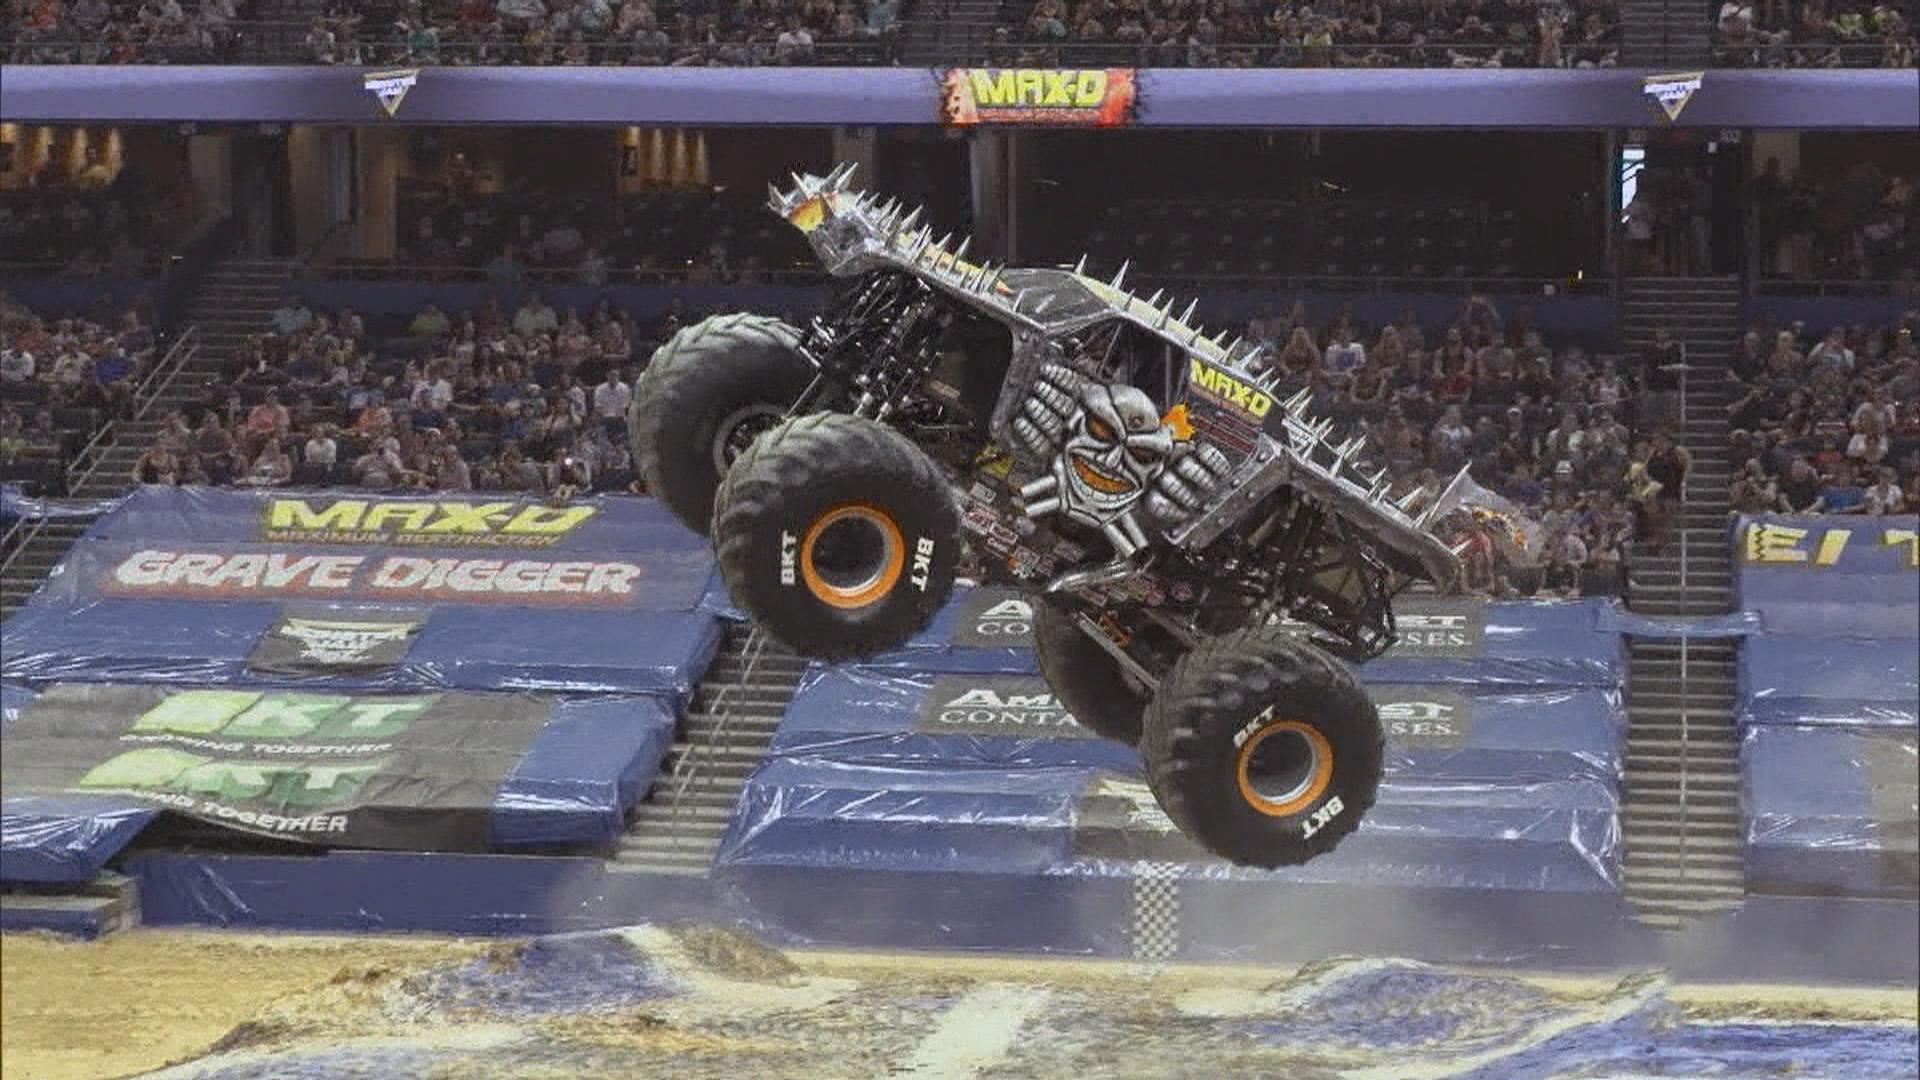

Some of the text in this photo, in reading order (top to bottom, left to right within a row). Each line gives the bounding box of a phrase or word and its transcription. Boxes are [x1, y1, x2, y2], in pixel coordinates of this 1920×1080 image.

[972, 69, 1106, 106] MAX-D
[1191, 357, 1272, 418] MAX-D
[270, 499, 597, 534] MAX-D
[115, 550, 641, 593] GRAVE DIGGER
[781, 529, 797, 586] BKT
[911, 537, 934, 592] BKT
[1233, 705, 1274, 748] BKT
[202, 800, 349, 833] TOGETHER
[1302, 795, 1345, 840] BKT
